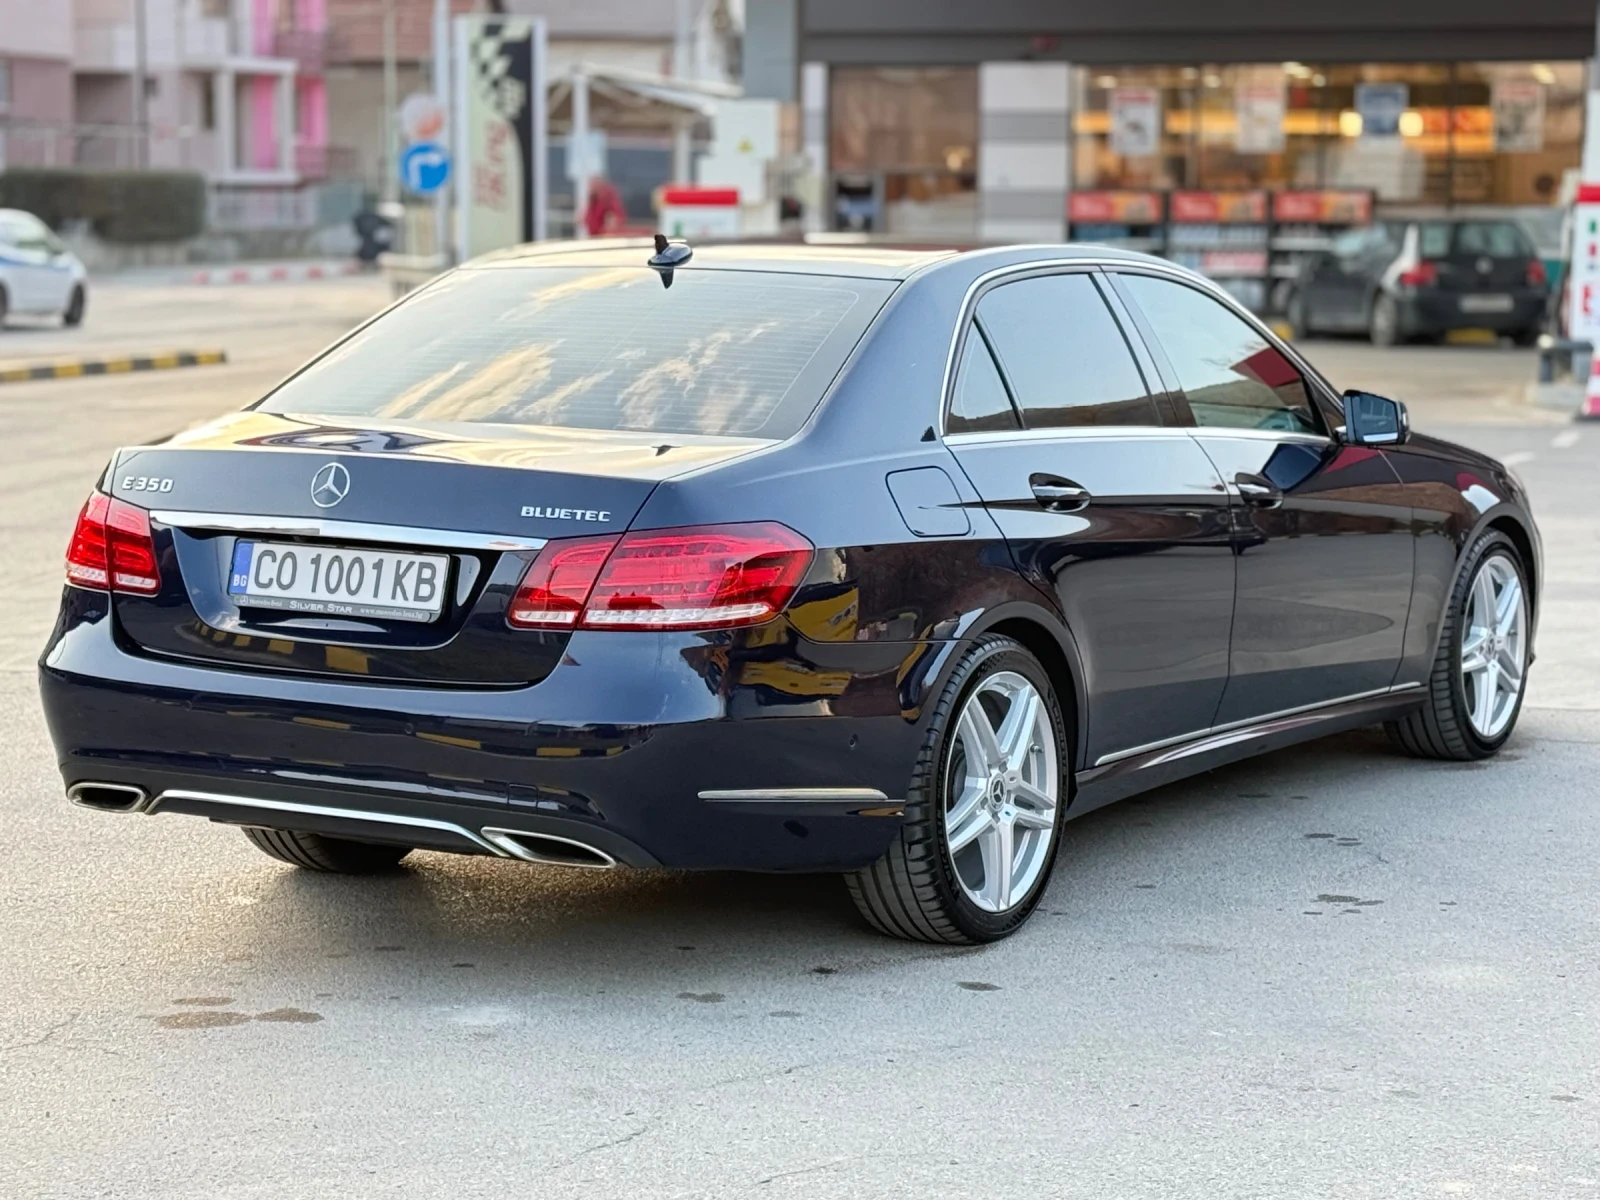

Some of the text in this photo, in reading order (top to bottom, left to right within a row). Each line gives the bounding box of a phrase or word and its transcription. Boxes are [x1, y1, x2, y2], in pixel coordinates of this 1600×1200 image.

[520, 505, 611, 522] BLUETEC
[232, 573, 248, 587] BG
[254, 549, 437, 603] CO 1001 KB
[289, 600, 324, 612] SILVER
[327, 603, 353, 614] STAR
